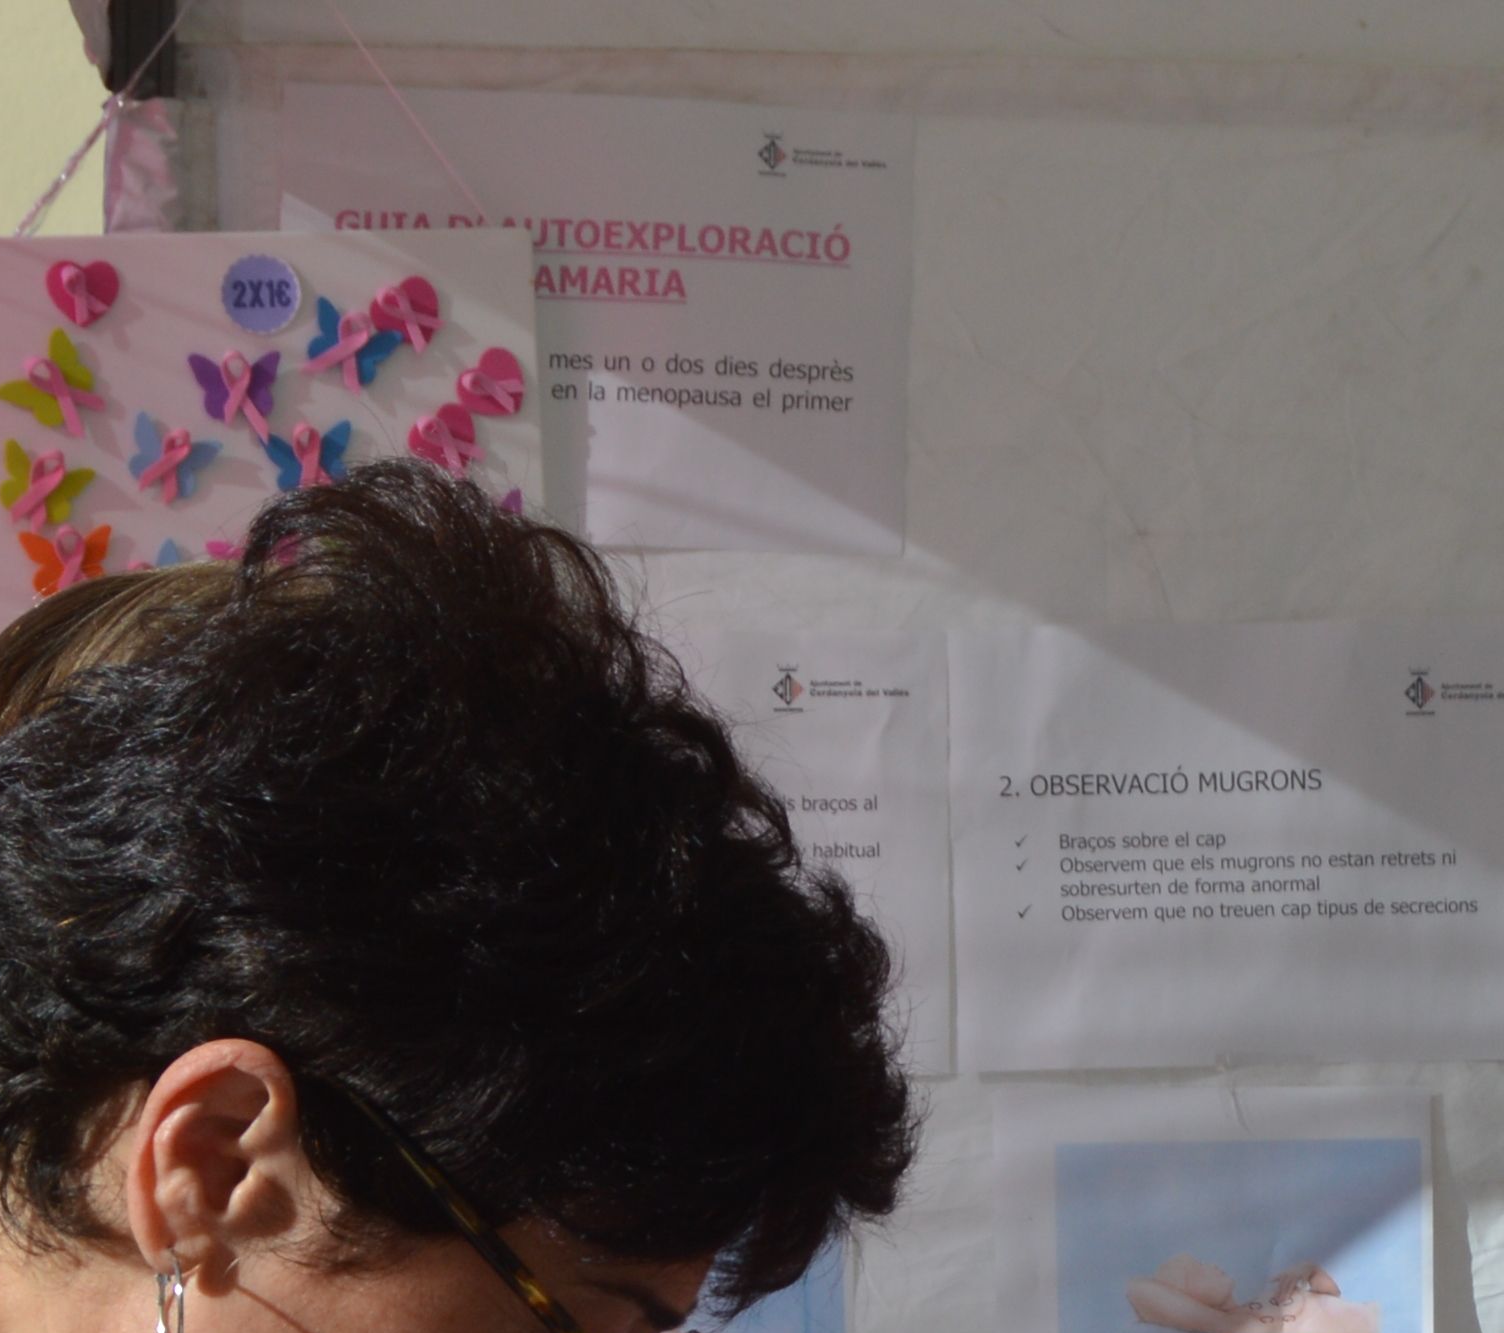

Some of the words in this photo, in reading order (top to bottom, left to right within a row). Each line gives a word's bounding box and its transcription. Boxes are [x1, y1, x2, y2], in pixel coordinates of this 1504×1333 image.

[548, 352, 593, 371] mes
[603, 354, 631, 372] un
[641, 357, 655, 372] o
[665, 353, 704, 375] dos
[714, 355, 758, 378] dies
[768, 357, 854, 384] desprès
[551, 382, 578, 400] en
[588, 380, 606, 400] la
[616, 385, 742, 409] menopausa
[752, 388, 771, 409] el
[781, 391, 853, 414] primer
[999, 776, 1021, 797] 2.
[1029, 766, 1189, 796] OBSERVACIÓ
[1198, 769, 1323, 793] MUGRONS
[801, 795, 858, 815] braços
[863, 793, 878, 811] al
[812, 841, 880, 858] habitual
[1058, 833, 1116, 853] Braços
[1121, 831, 1171, 849] sobre
[1174, 830, 1190, 848] el
[1195, 833, 1227, 852] cap
[1059, 856, 1147, 874] Observem
[1152, 858, 1186, 876] que
[1190, 853, 1214, 870] els
[1220, 855, 1296, 874] mugrons
[1301, 854, 1323, 869] no
[1328, 851, 1374, 868] estan
[1380, 849, 1436, 866] retrets
[1441, 849, 1458, 865] ni
[1060, 879, 1162, 898] sobresurten
[1167, 878, 1190, 896] de
[1194, 877, 1246, 895] forma
[1250, 875, 1321, 893] anormal
[1061, 904, 1149, 922] Observem
[1154, 905, 1187, 922] que
[1191, 904, 1215, 919] no
[1219, 902, 1276, 918] treuen
[1281, 903, 1312, 921] cap
[1316, 899, 1359, 919] tipus
[1363, 898, 1385, 915] de
[1390, 898, 1479, 915] secrecions
